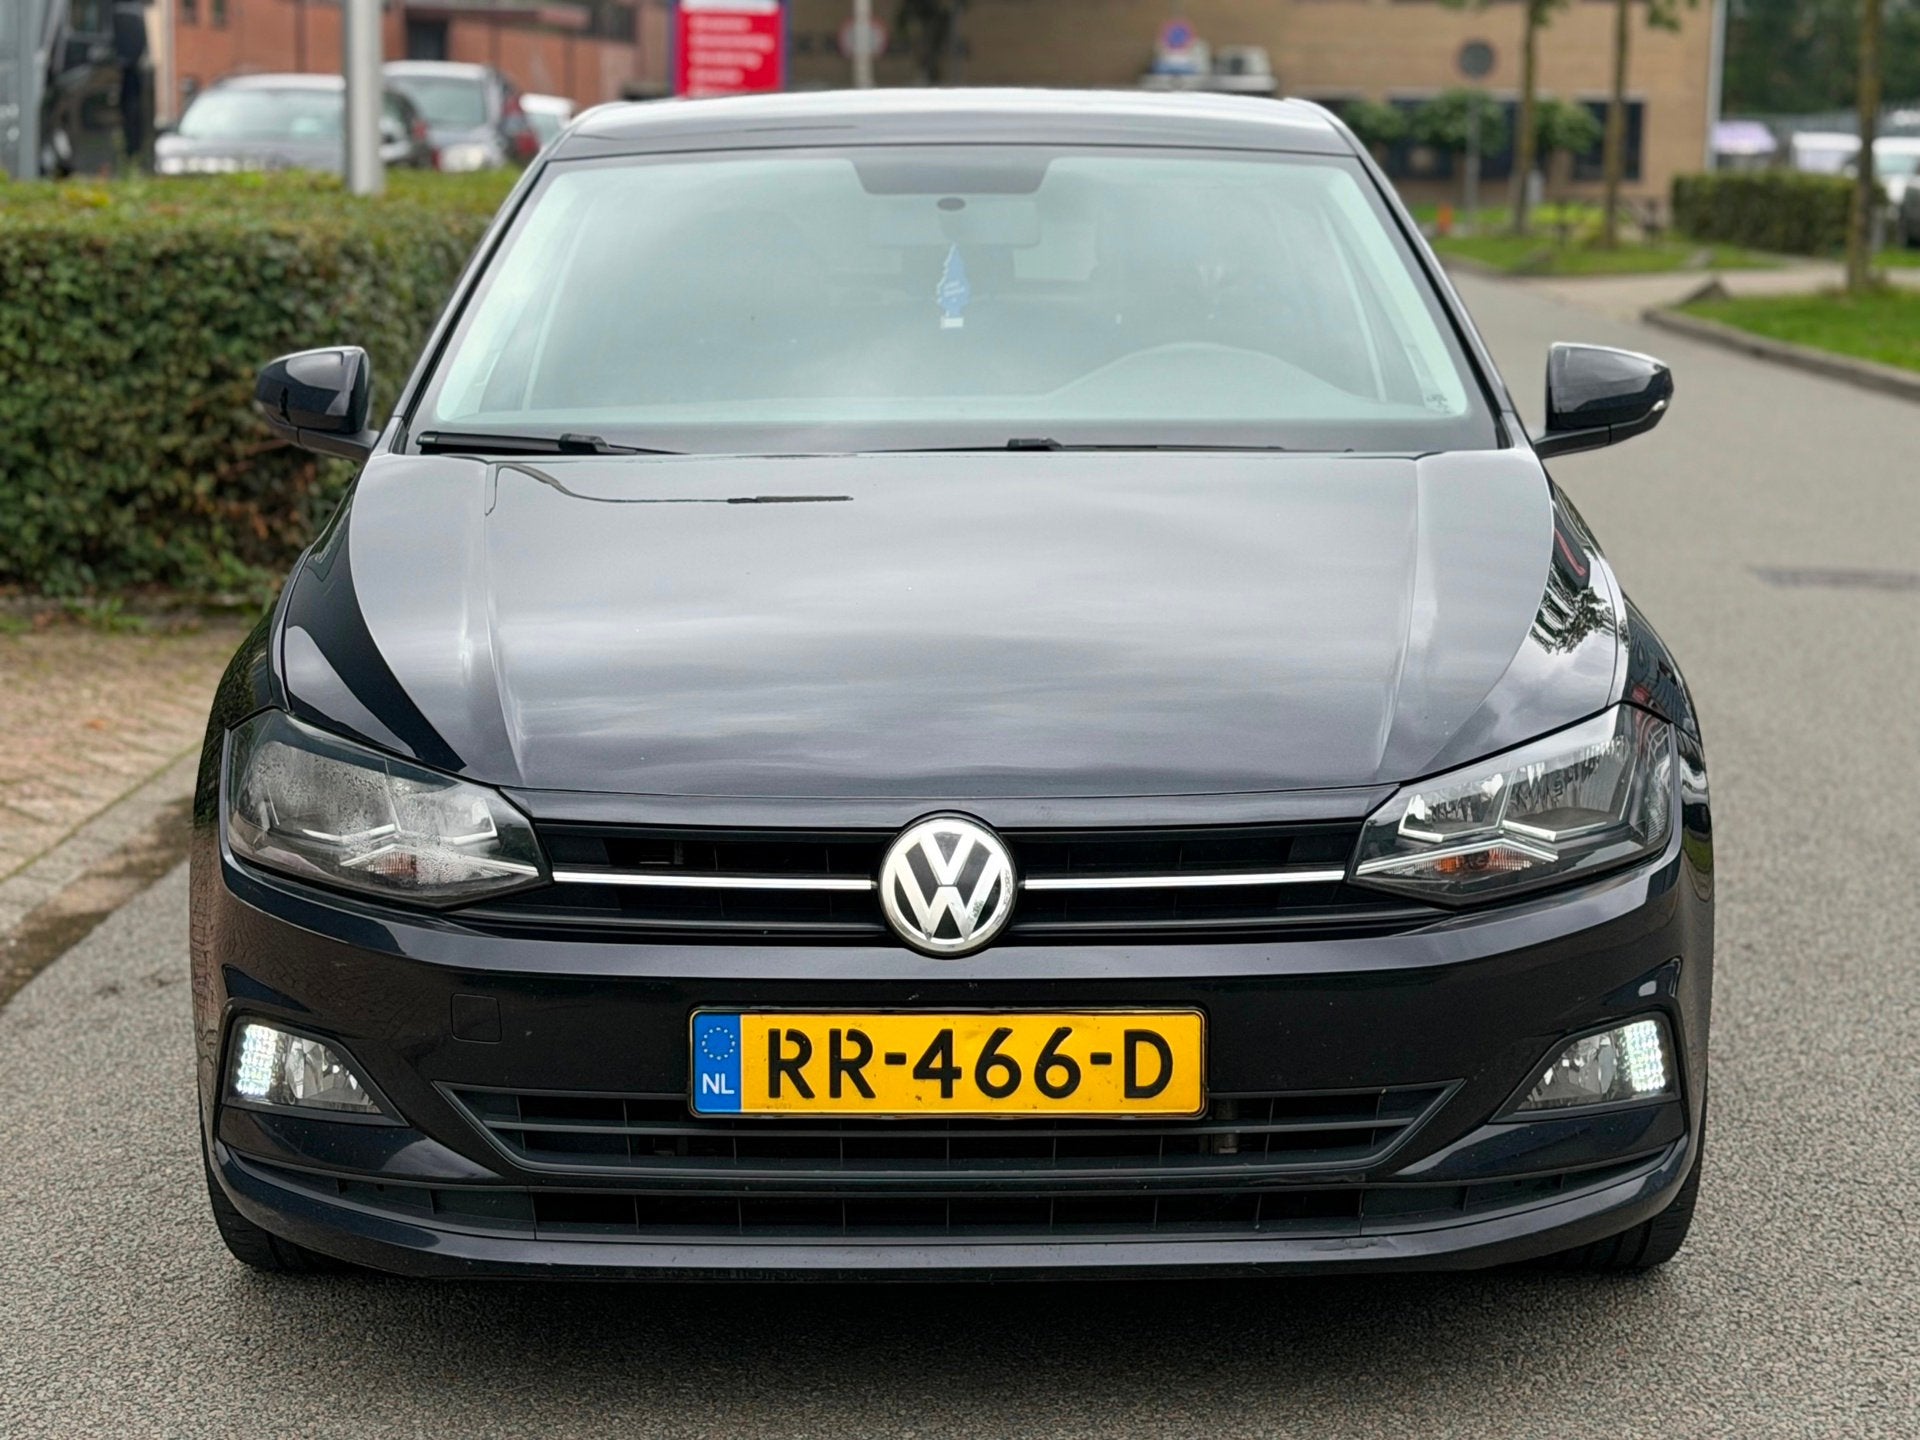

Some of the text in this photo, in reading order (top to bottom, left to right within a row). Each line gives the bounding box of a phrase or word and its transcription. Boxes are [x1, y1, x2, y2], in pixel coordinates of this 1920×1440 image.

[884, 822, 1011, 948] VW
[702, 1072, 735, 1095] NL
[767, 1026, 1173, 1099] RR-466-D
